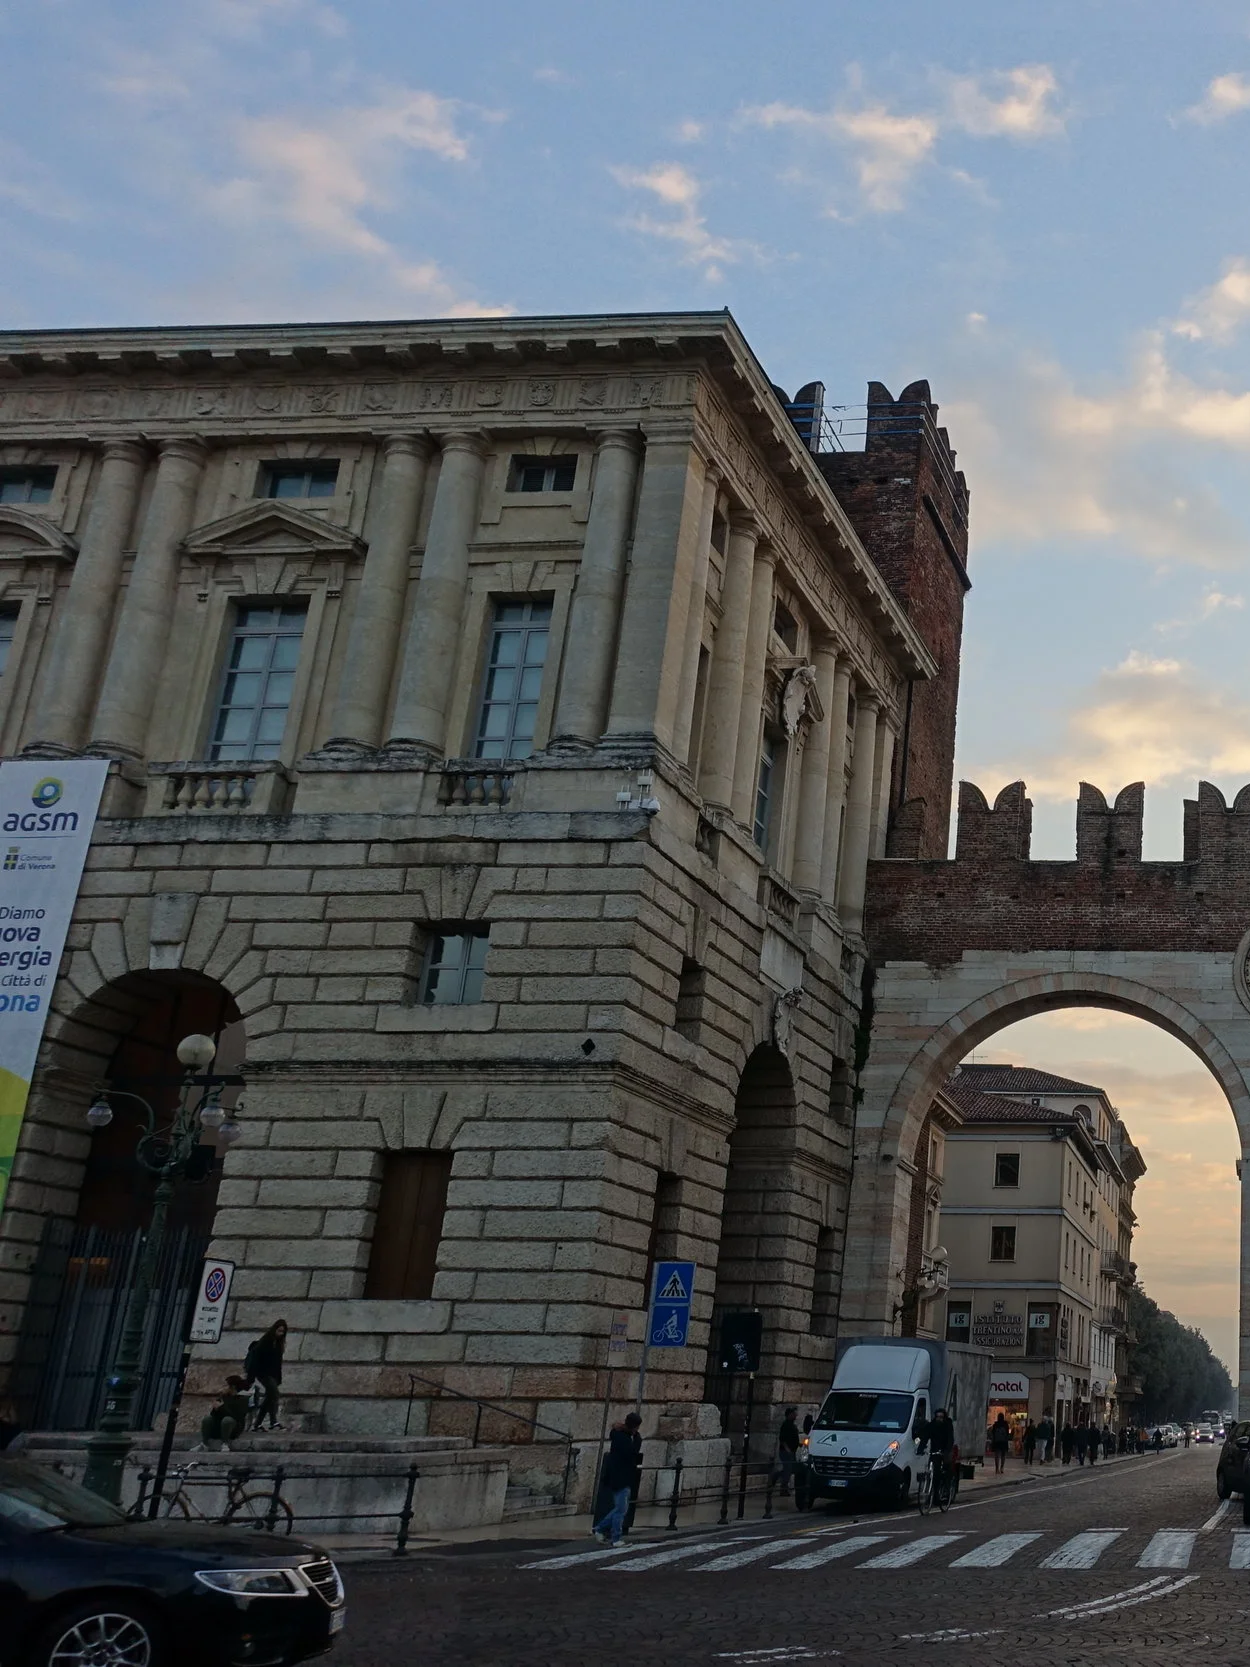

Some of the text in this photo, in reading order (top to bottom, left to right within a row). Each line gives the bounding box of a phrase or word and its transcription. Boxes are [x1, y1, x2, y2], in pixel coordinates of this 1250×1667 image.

[20, 854, 52, 862] Comune
[0, 906, 45, 920] Diamo
[0, 926, 40, 942] ova
[0, 946, 52, 970] ergia
[1, 974, 47, 986] Città di
[974, 1315, 1023, 1324] ISTITUTO
[973, 1326, 1011, 1335] TRENTINO
[973, 1336, 1024, 1346] ASSICURAZIONI
[990, 1381, 1023, 1393] natal
